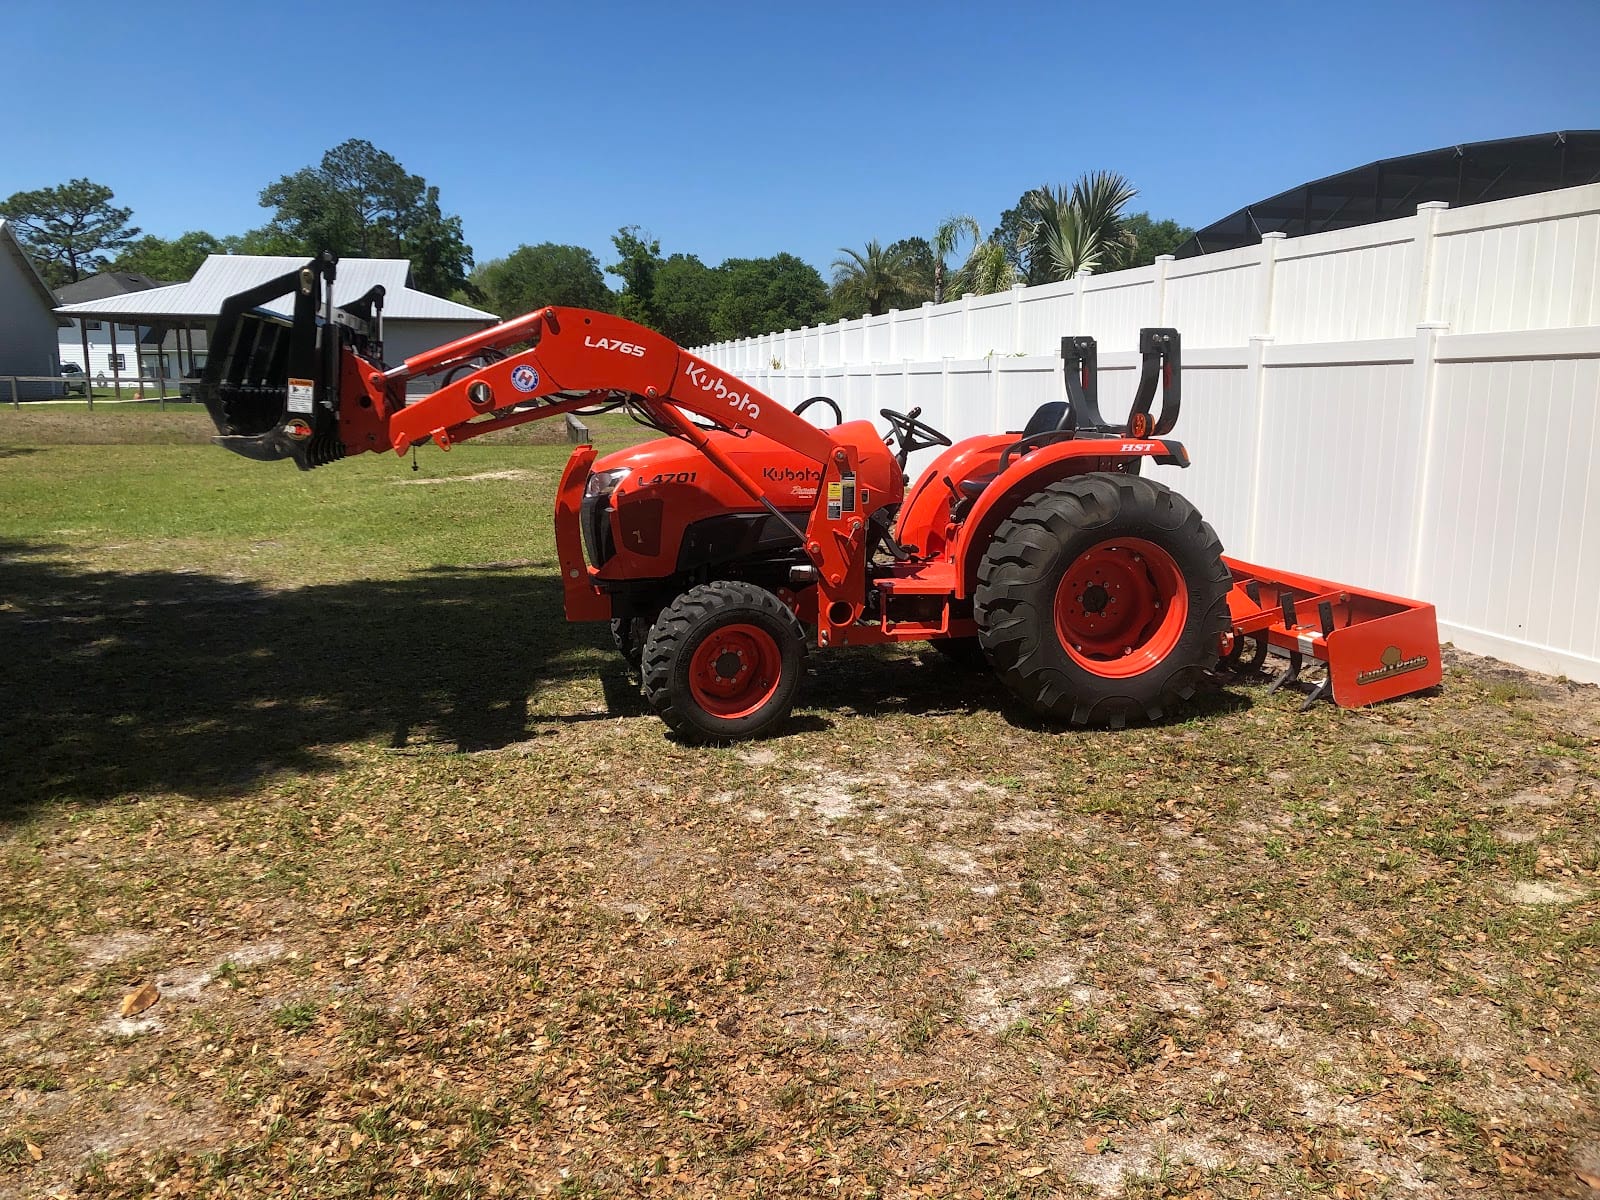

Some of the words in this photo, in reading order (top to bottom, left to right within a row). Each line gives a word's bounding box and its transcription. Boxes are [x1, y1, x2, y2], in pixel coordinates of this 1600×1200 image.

[584, 335, 646, 358] LA765
[684, 361, 761, 420] Kubota
[1120, 443, 1155, 452] HST
[763, 467, 821, 481] Kubota
